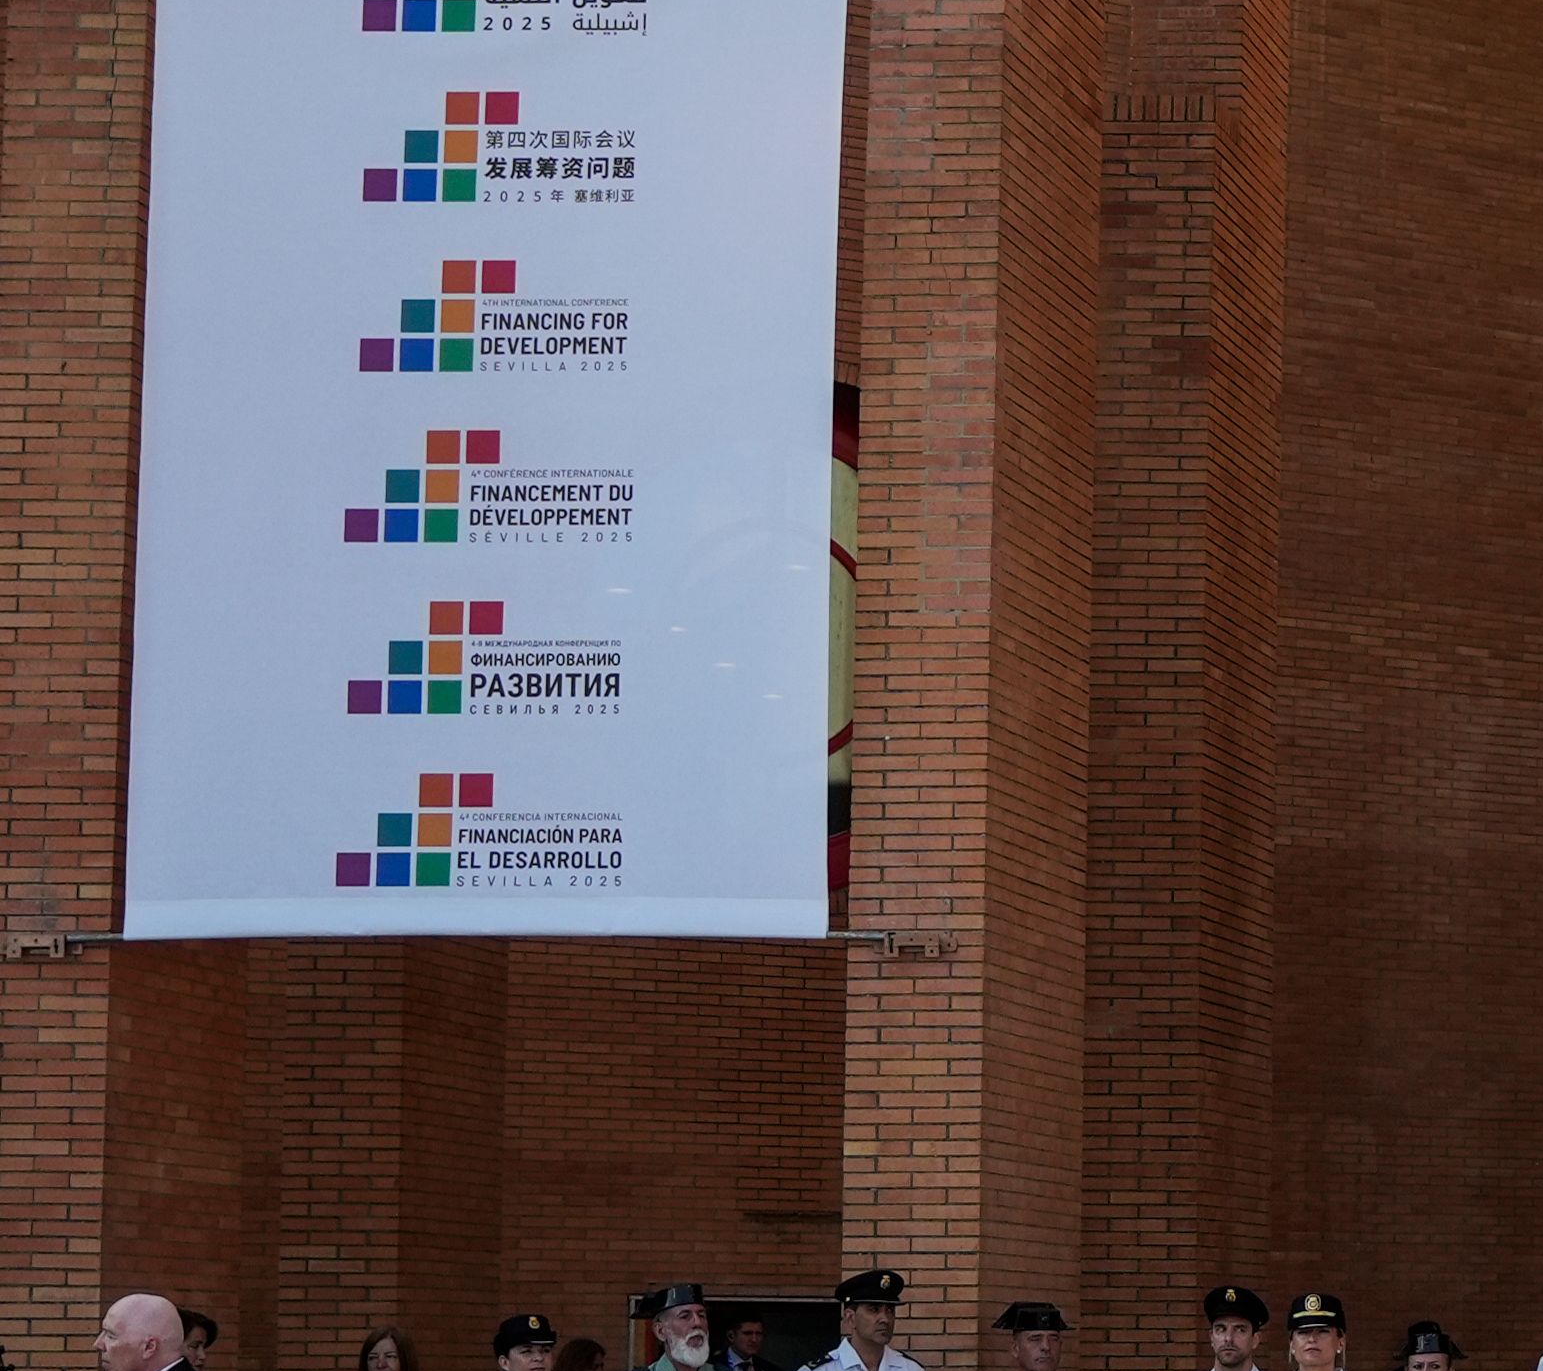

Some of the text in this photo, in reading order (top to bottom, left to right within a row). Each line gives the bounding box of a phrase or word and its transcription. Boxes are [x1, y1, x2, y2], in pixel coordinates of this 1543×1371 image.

[483, 13, 648, 37] إشبيلية 2025
[485, 130, 636, 149] 第四次国际会议
[483, 157, 635, 180] 发展筹资问题
[483, 189, 635, 203] 2025年 塞维利亚
[501, 299, 569, 307] INTERNATIONAL
[482, 313, 627, 330] FINANCING FOR
[481, 337, 627, 354] DEVELOPMENT
[480, 361, 627, 371] SEVILLA 2025
[484, 469, 548, 478] CONFÉRENCE
[551, 469, 633, 478] INTERNATIONALE
[471, 485, 632, 501] FINANCEMENT DU
[470, 505, 632, 526] DÉVELOPPEMENT
[470, 531, 632, 543] SÉVILLE 2025
[471, 653, 620, 666] ФИНАНСИРОВАНИЮ
[471, 673, 619, 697] РАЗВИТИЯ
[470, 704, 619, 715] СЕВИЛЬЯ 2025
[472, 813, 541, 821] CONFERENCIA
[544, 813, 622, 821] INTERNACIONAL
[459, 825, 622, 843] FINANCIACIÓN PARA
[458, 851, 621, 869] EL DESARROLLO
[457, 876, 621, 887] SEVILLA 2025
